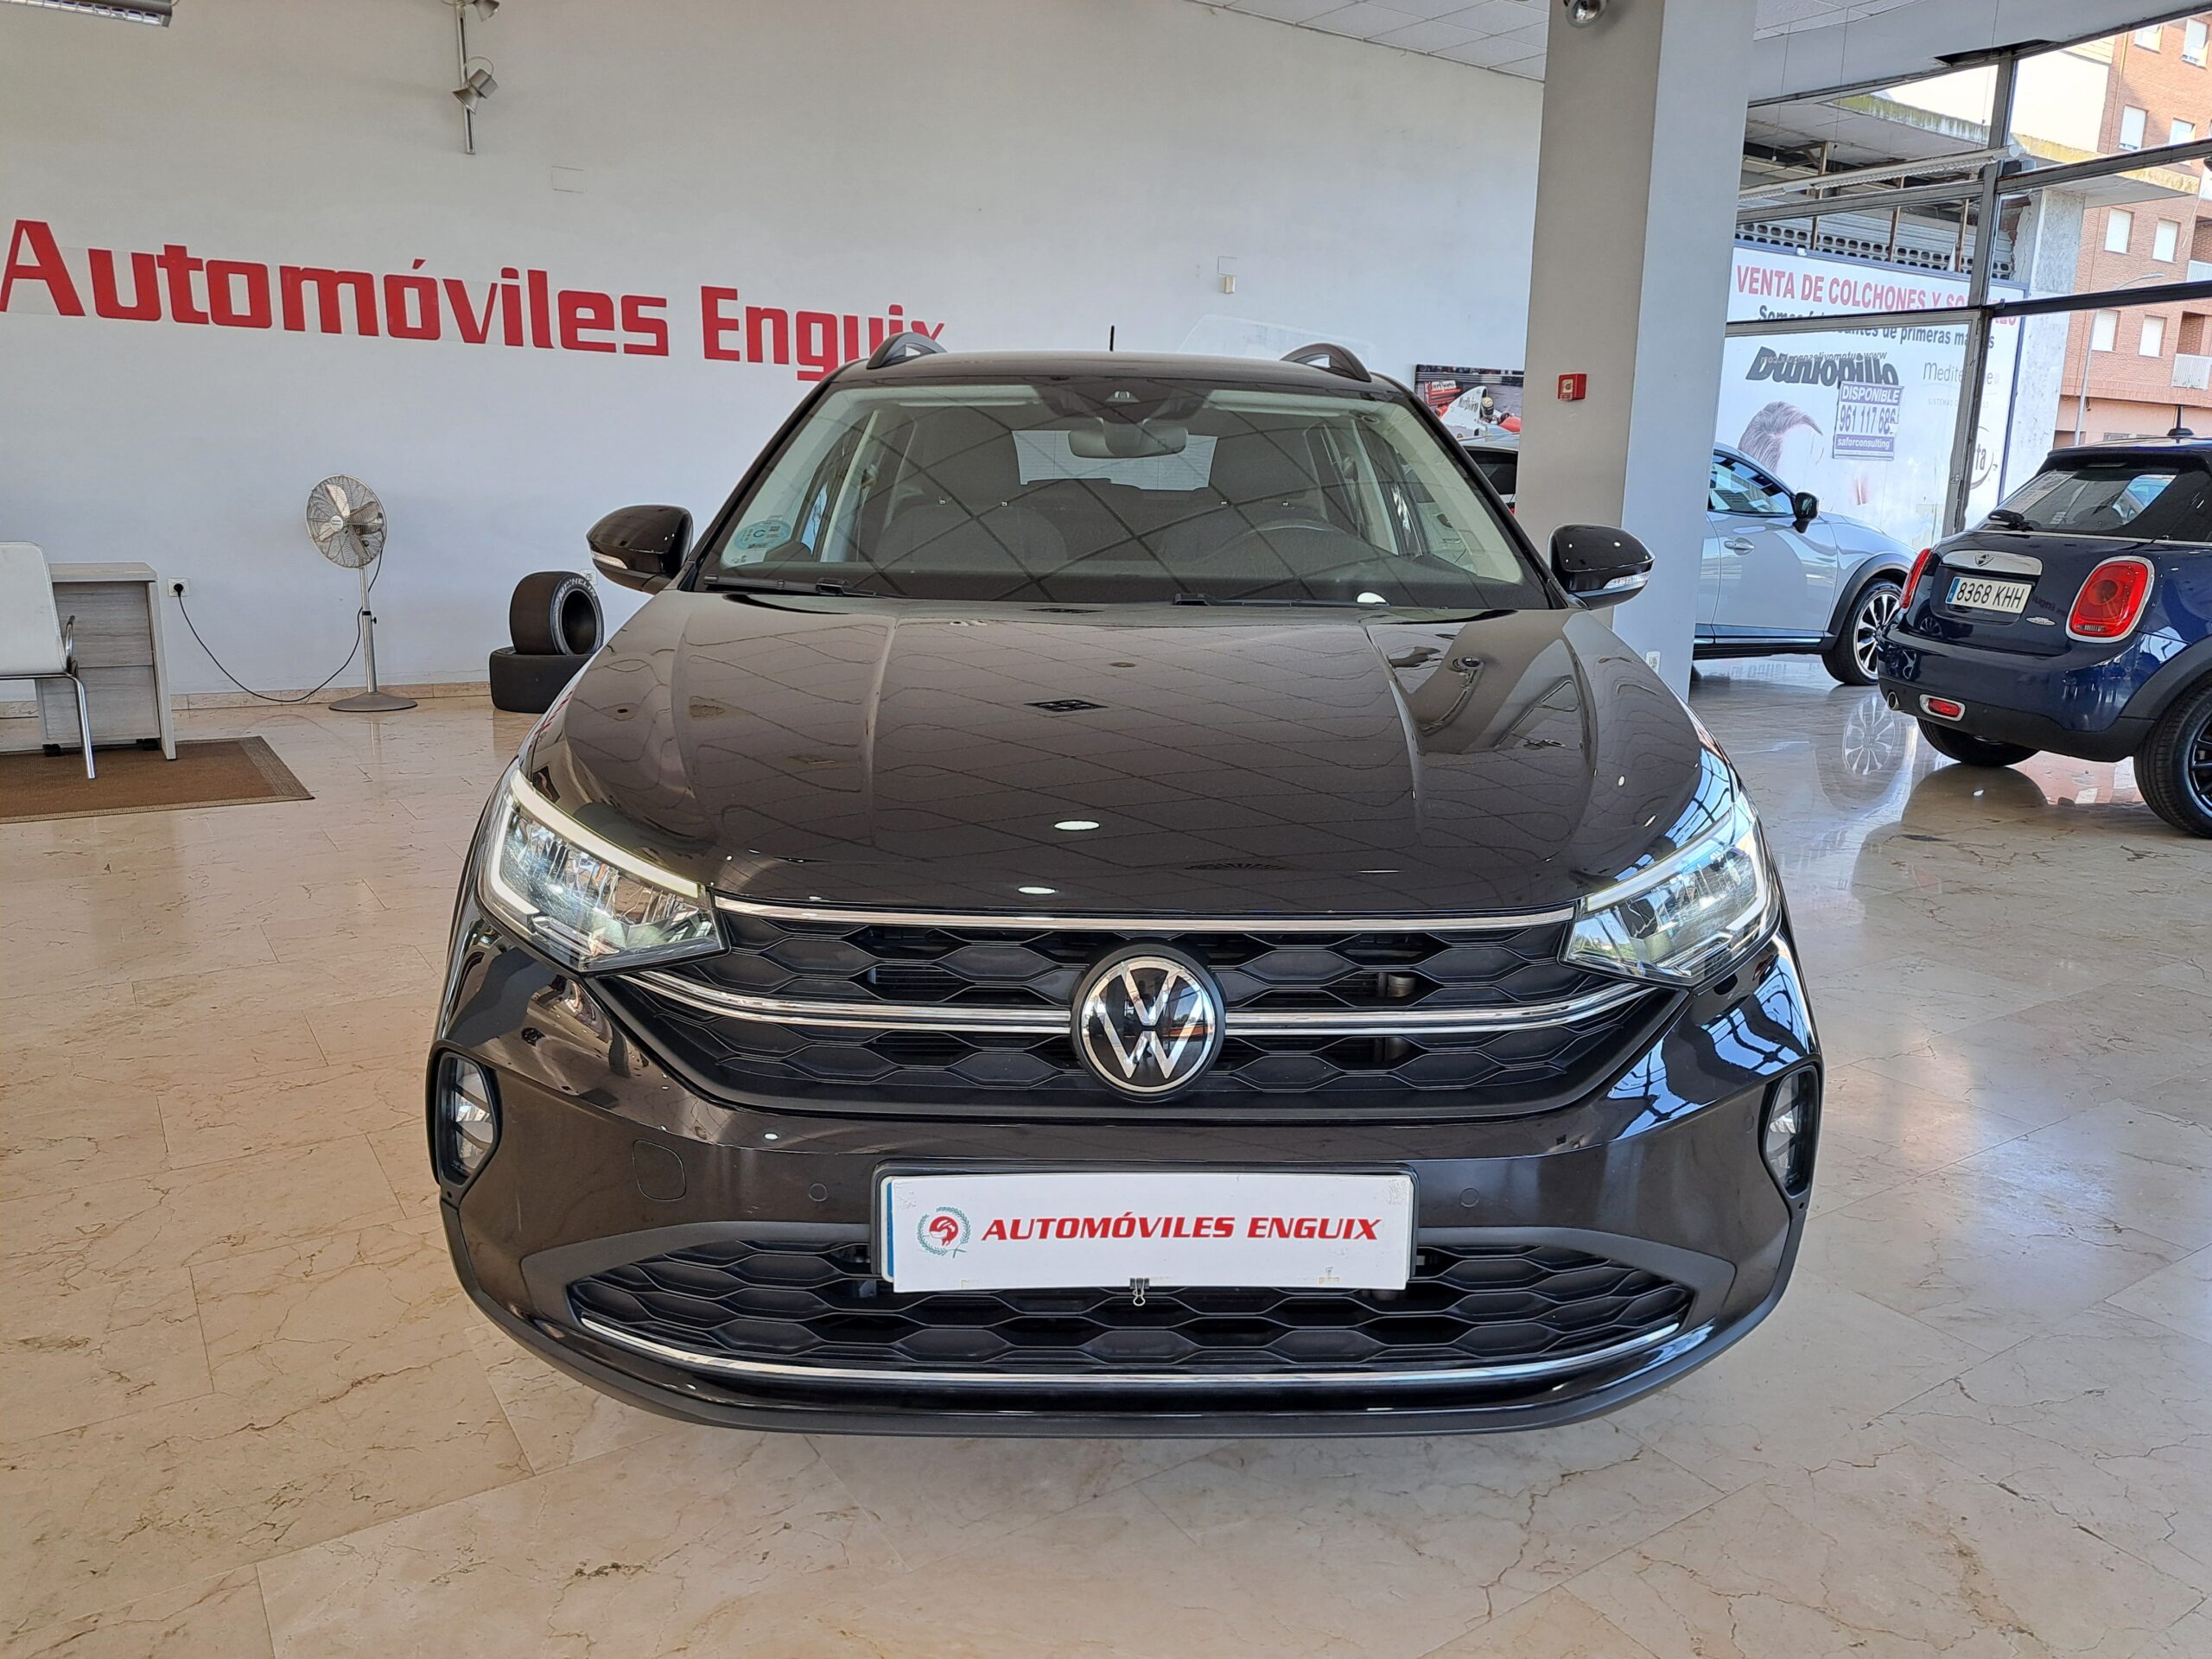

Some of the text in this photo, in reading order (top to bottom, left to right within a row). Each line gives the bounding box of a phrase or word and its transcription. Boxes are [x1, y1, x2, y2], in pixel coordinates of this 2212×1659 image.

[0, 219, 669, 356] Automóviles
[1737, 265, 1795, 299] VENTA
[1801, 274, 1824, 302] DE
[1828, 277, 1926, 311] COLCHONES
[1900, 327, 1951, 345] primeras
[1842, 385, 1899, 403] DISPONIBLE
[1839, 404, 1857, 432] 961
[1860, 405, 1877, 433] 117
[1837, 436, 1891, 450] saforconsulting
[558, 577, 597, 601] MICHELIN
[1956, 582, 1993, 604] 8368
[1992, 585, 2025, 609] KHH
[981, 1211, 1382, 1241] AUTOMÓVILES ENGUIX
